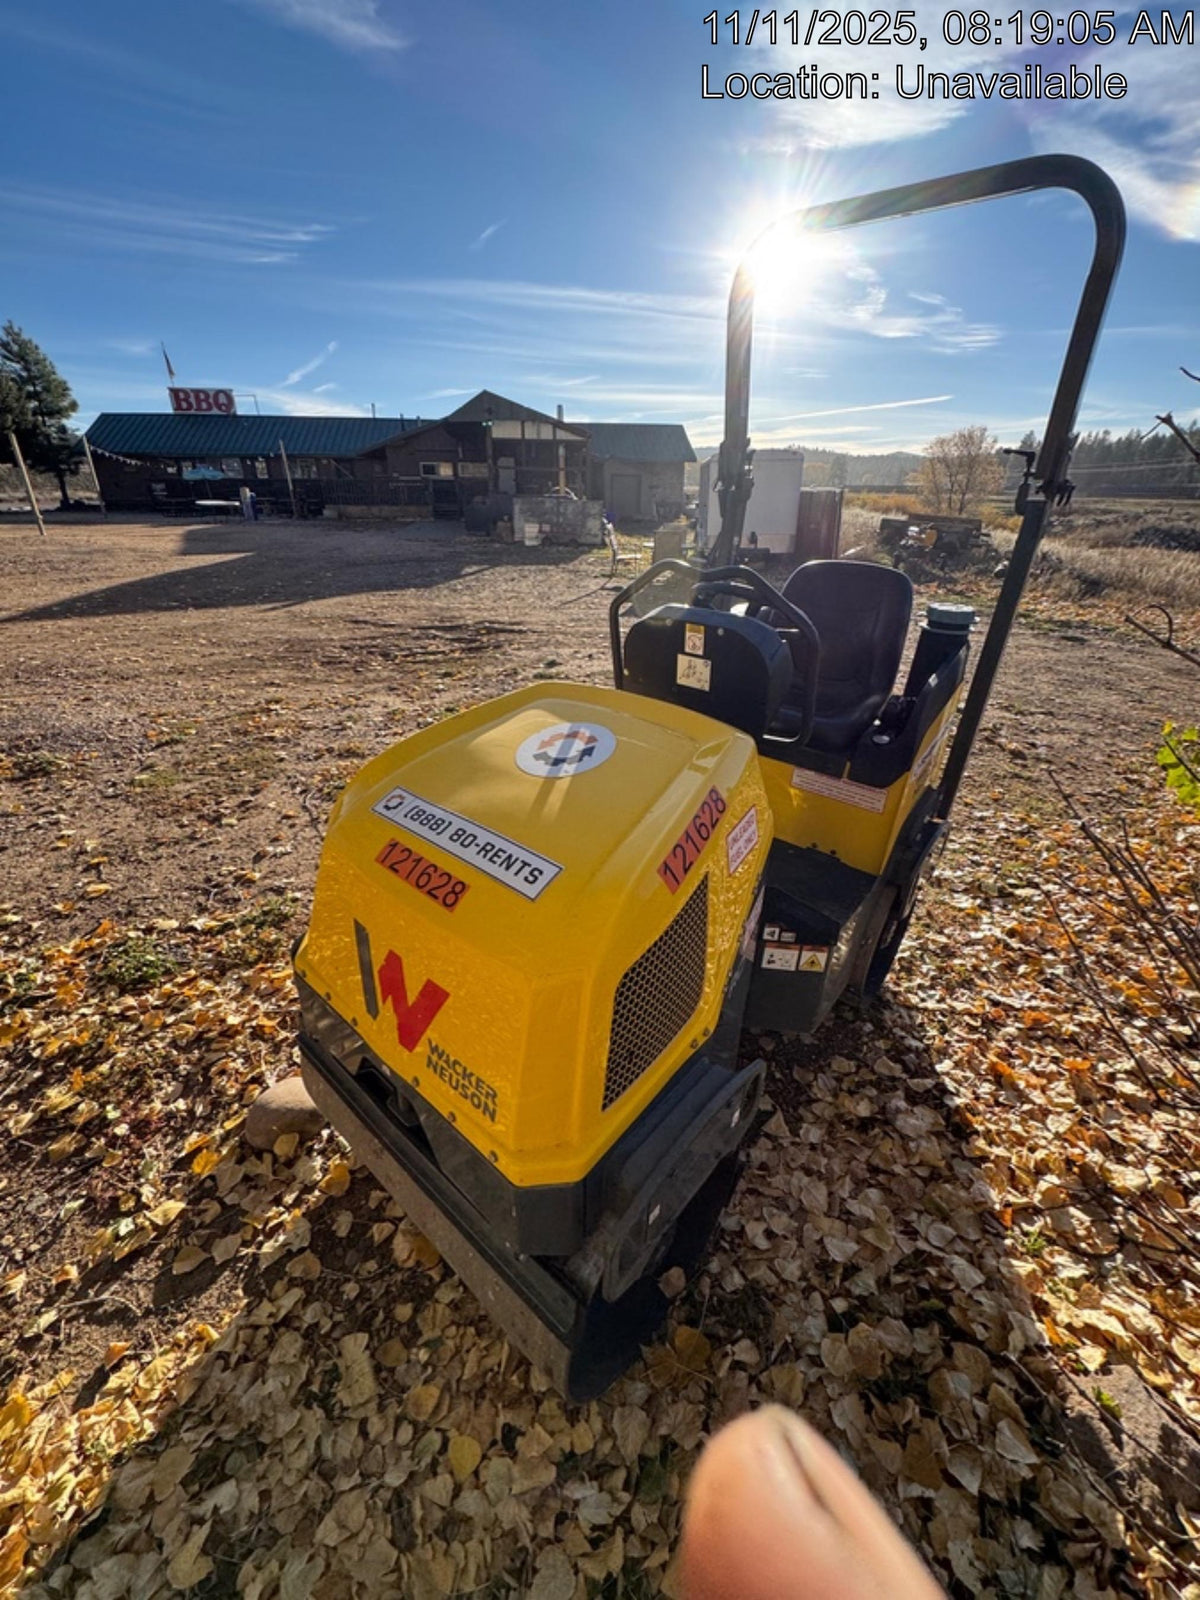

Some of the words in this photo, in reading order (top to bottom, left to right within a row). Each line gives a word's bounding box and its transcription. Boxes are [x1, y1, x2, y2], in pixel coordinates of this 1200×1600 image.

[172, 388, 235, 413] BBQ
[404, 804, 452, 833] (888)
[448, 827, 544, 886] 80-RENTS
[662, 788, 727, 886] 121628
[379, 841, 466, 909] 121628
[427, 1056, 498, 1123] NEUSON
[429, 1038, 498, 1106] WACKER
